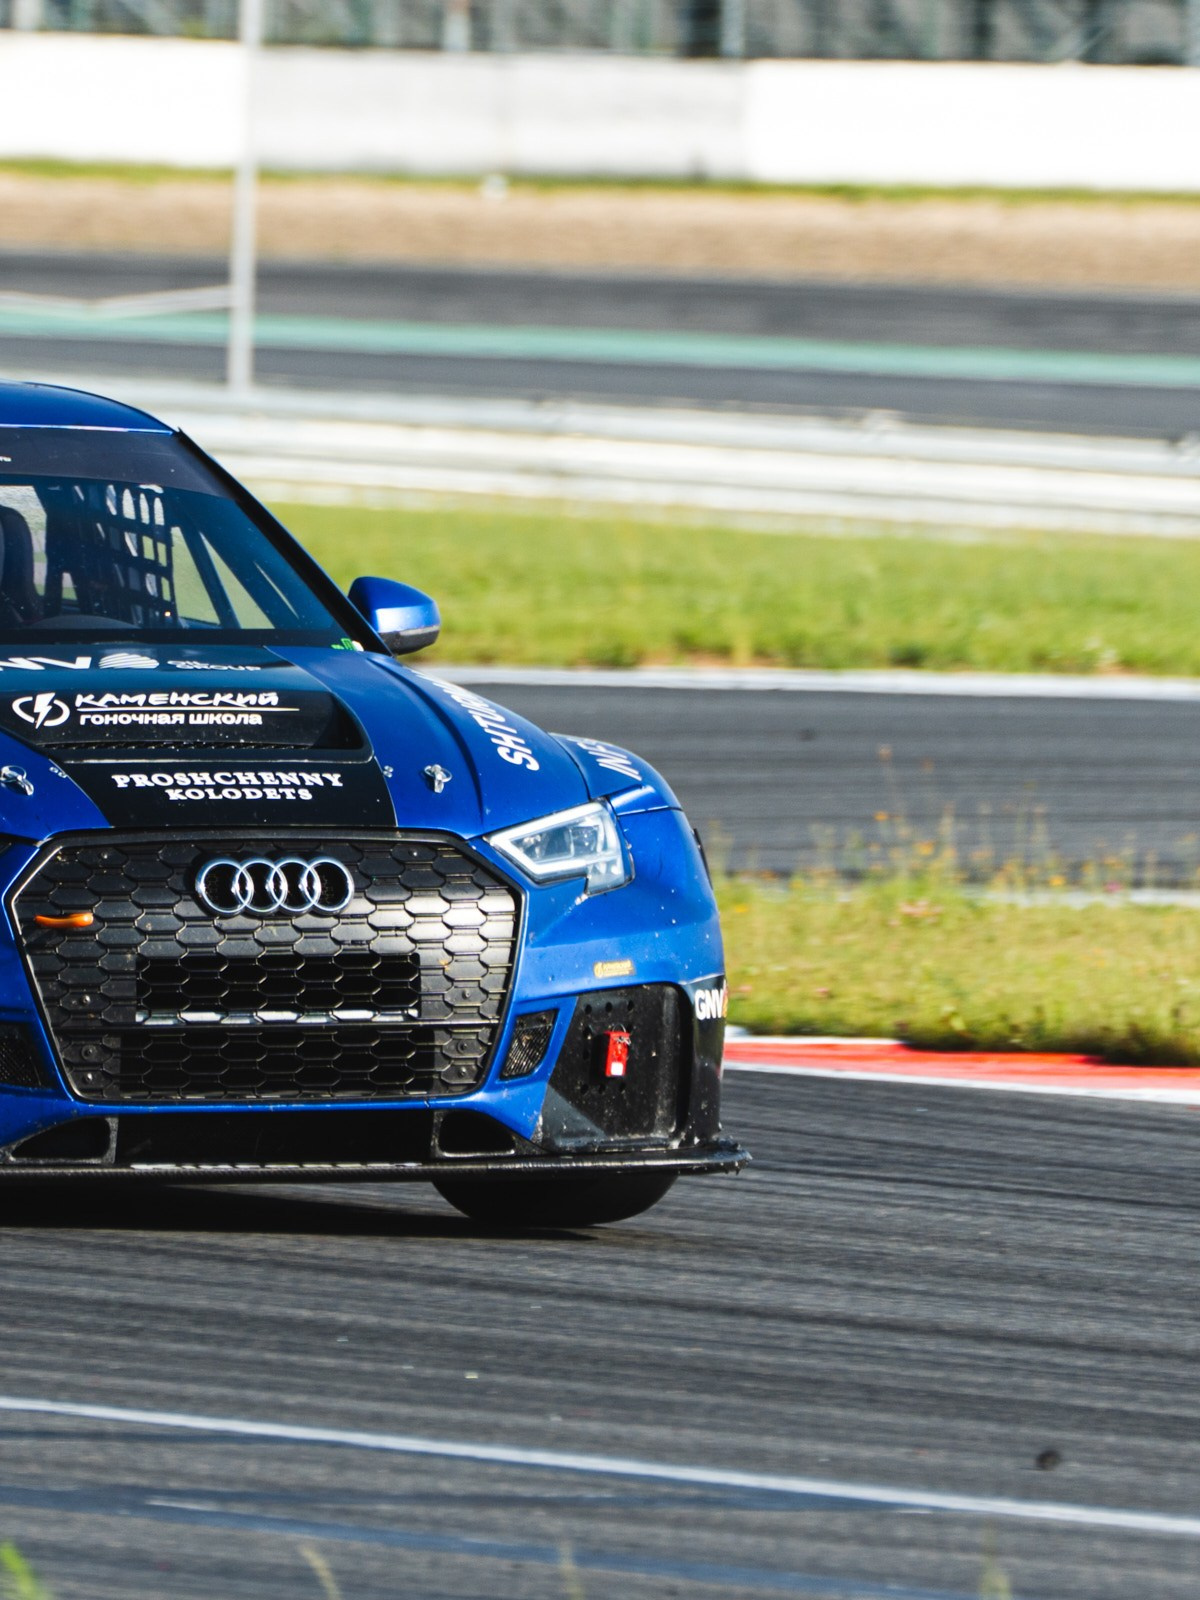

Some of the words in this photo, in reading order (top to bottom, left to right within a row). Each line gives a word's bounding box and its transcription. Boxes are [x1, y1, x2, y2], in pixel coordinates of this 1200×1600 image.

[75, 692, 279, 708] КАМЕНСКИЙ
[79, 713, 185, 726] гоночная
[189, 713, 263, 726] школа
[111, 771, 343, 788] PROSHCHENNY
[166, 786, 314, 801] KOLODETS
[694, 988, 725, 1021] GNV
